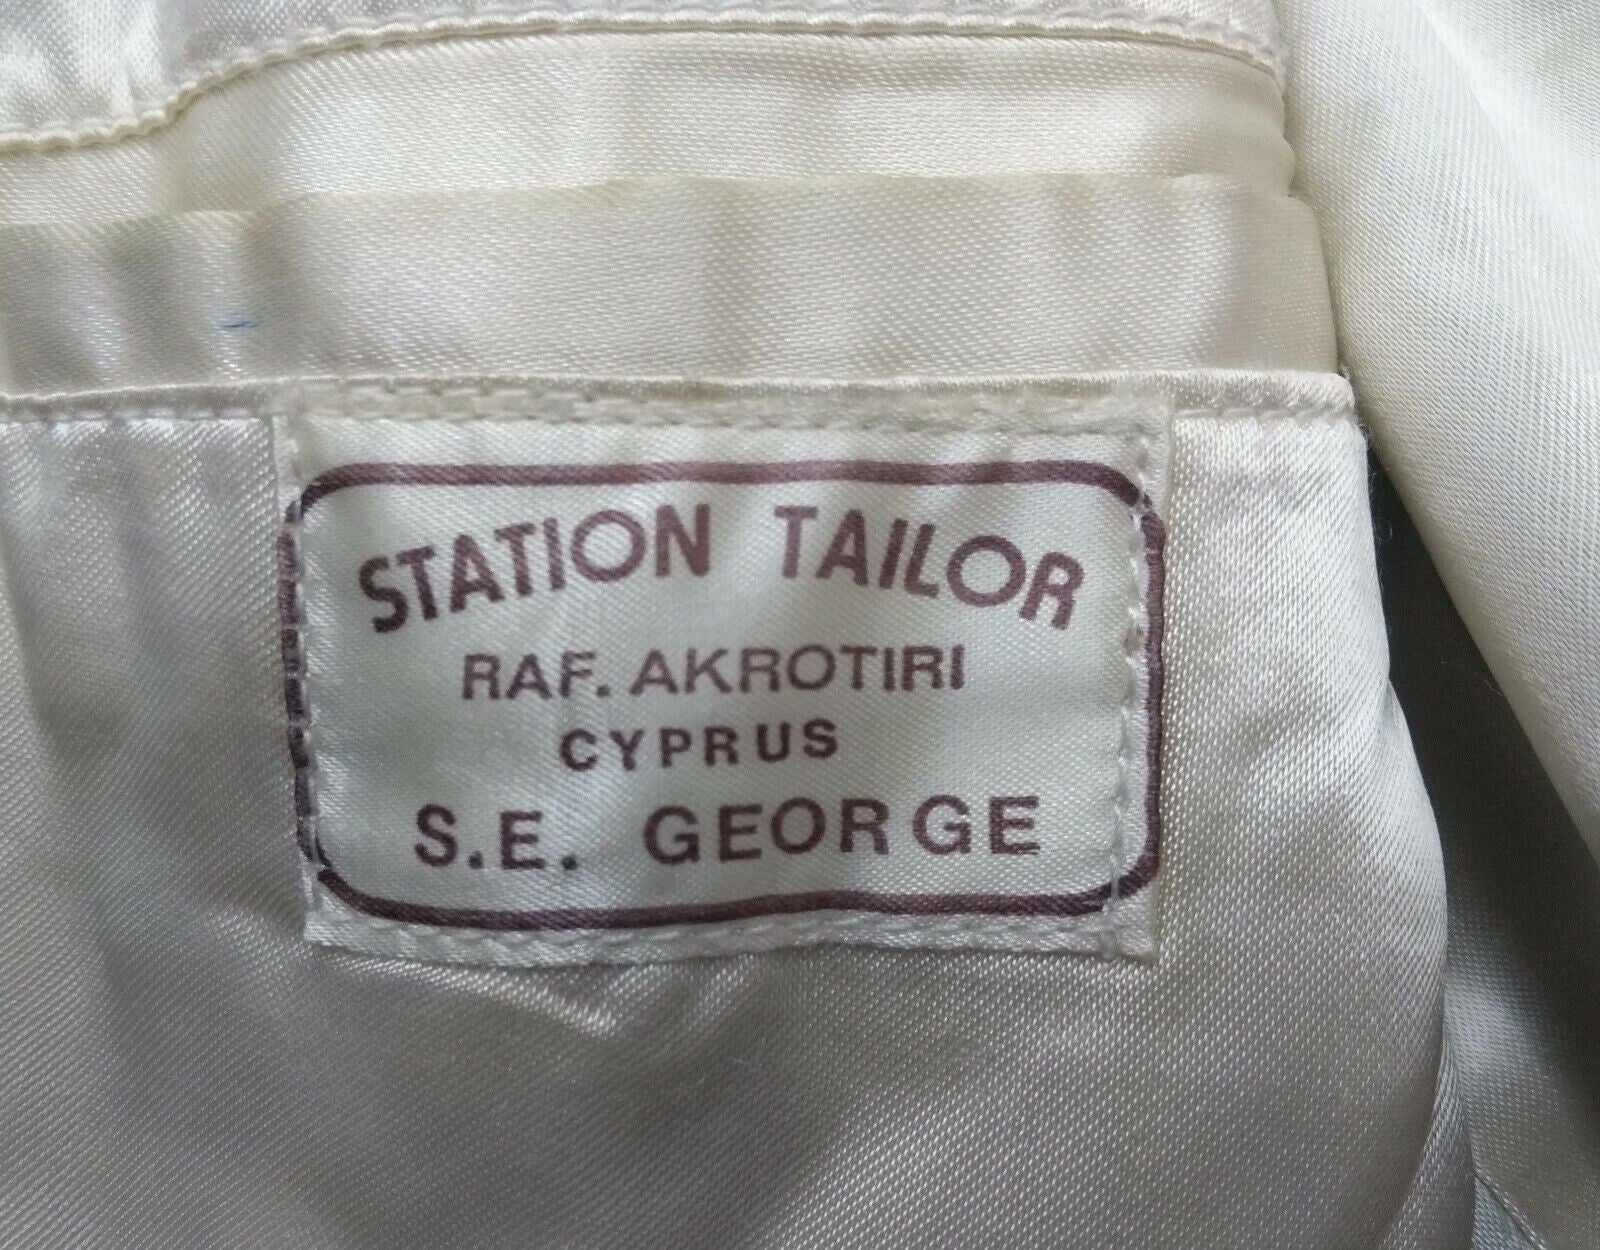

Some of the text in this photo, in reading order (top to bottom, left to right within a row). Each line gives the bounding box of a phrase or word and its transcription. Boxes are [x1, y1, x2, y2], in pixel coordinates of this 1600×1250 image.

[358, 503, 1085, 634] STATION TAILOR
[462, 644, 966, 700] RAF. AKROTIRI
[558, 718, 839, 773] CYPRUS
[414, 794, 1042, 871] S.E. GEORGE
